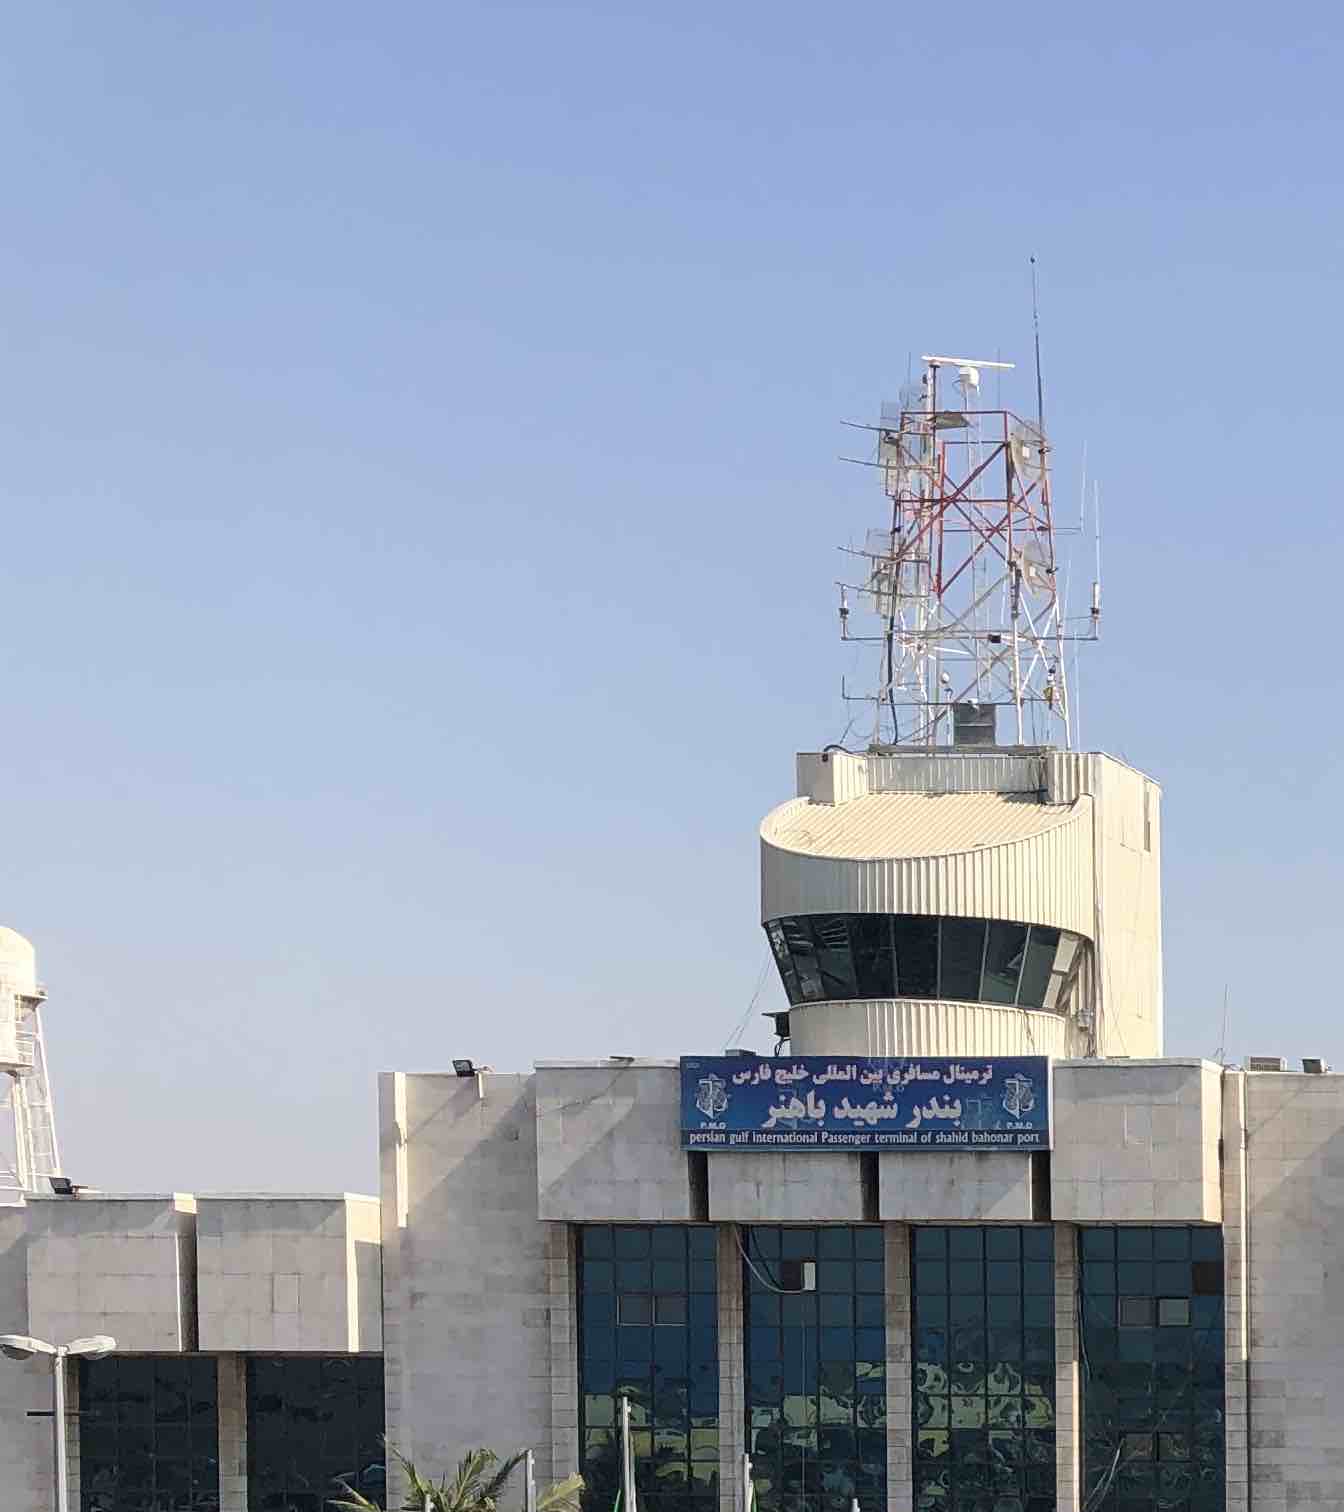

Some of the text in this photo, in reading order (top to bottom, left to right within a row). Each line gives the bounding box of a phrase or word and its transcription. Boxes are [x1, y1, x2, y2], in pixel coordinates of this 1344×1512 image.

[732, 1065, 771, 1084] فارس
[774, 1063, 809, 1085] خلیج
[887, 1066, 940, 1086] مسافری
[943, 1065, 993, 1083] ترمینال
[761, 1089, 962, 1128] بندر شهید باهنر
[689, 1132, 725, 1145] persian
[730, 1131, 748, 1145] gulf
[821, 1131, 870, 1145] Passenger
[875, 1131, 917, 1143] terminal
[921, 1131, 932, 1142] of
[936, 1131, 968, 1143] shahid
[972, 1132, 1014, 1143] bahonar
[1017, 1132, 1039, 1145] port
